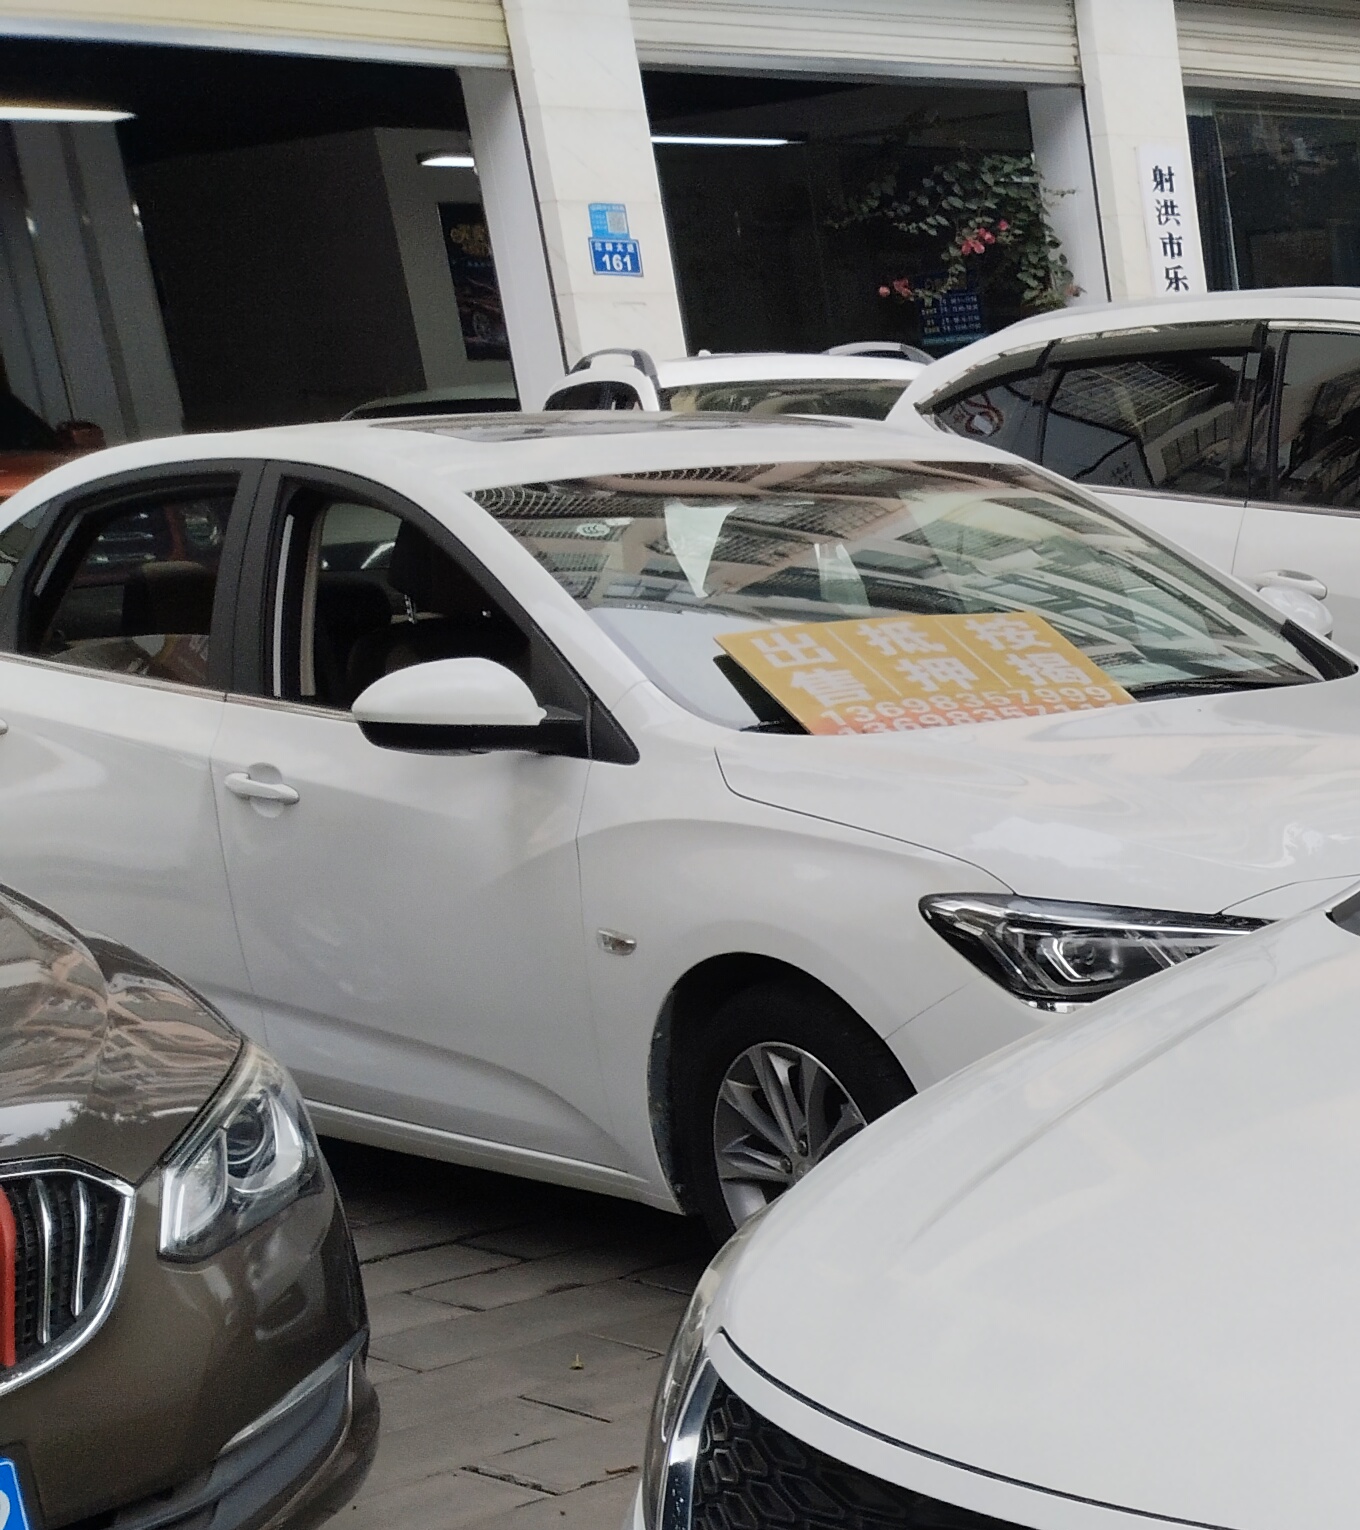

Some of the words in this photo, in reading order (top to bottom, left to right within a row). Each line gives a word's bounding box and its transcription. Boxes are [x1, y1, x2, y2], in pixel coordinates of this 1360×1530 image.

[602, 254, 632, 271] 161
[1152, 165, 1190, 292] 射洪市乐
[750, 632, 874, 707] 出售
[856, 619, 981, 693] 抵押
[964, 617, 1093, 687] 按揭
[820, 686, 1112, 726] 13698357999
